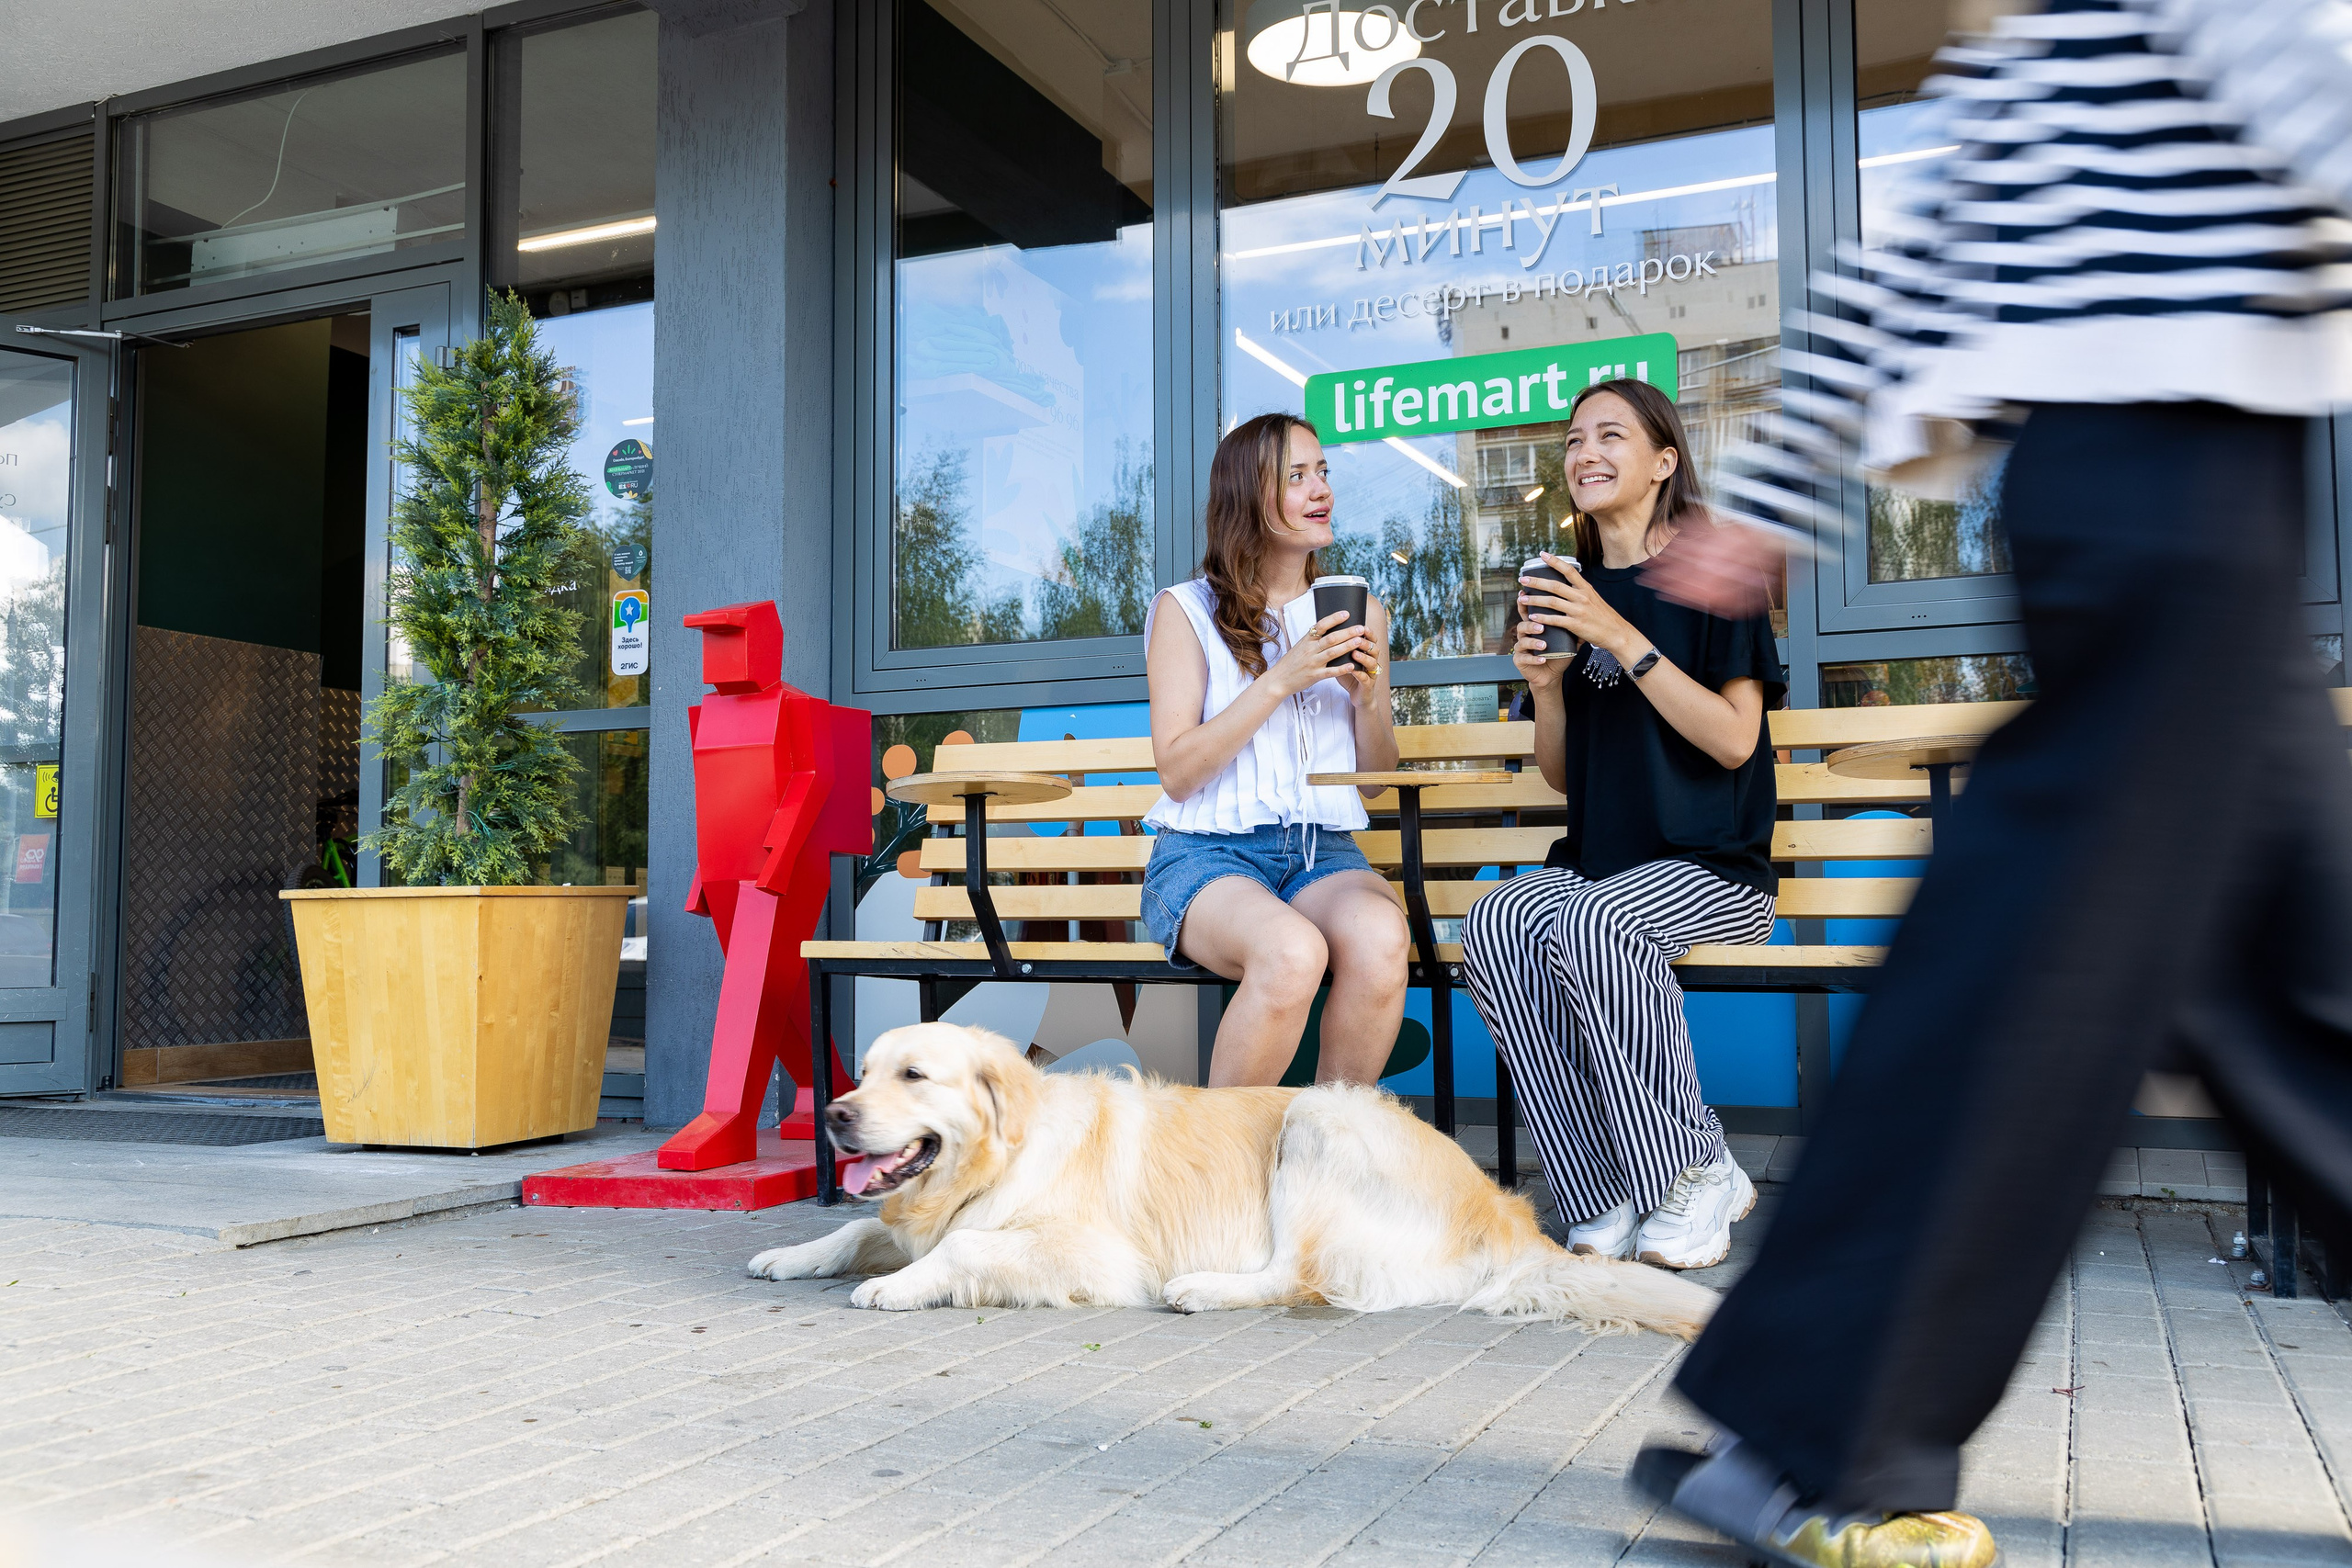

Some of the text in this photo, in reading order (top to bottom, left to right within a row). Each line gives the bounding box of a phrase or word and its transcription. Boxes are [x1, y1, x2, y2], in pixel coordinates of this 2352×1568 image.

[1366, 35, 1598, 211] 20
[1355, 183, 1620, 269] минут
[1271, 251, 1717, 333] или десерт в подарок
[617, 642, 643, 650] хорошо!
